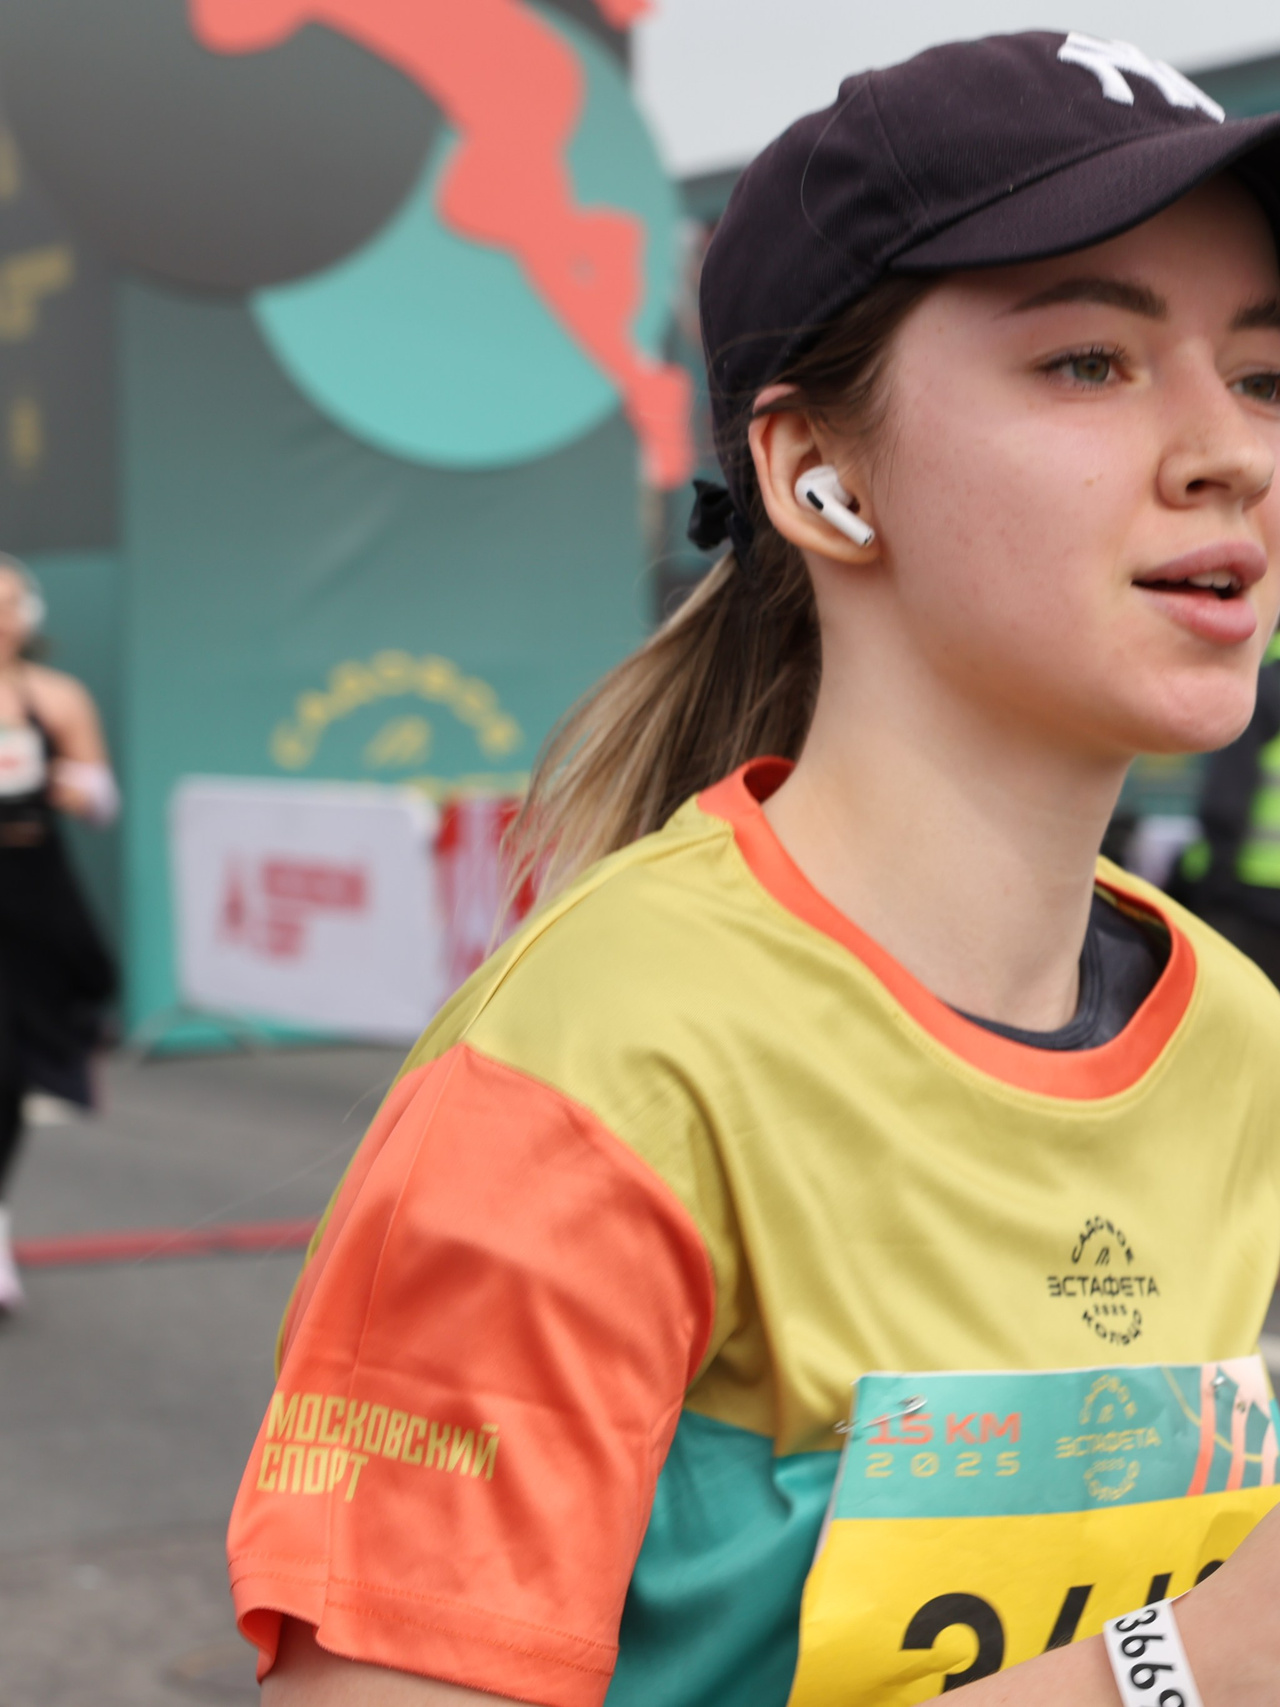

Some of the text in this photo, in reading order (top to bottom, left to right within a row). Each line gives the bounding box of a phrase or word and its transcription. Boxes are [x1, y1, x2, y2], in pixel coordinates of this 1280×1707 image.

[1047, 1274, 1160, 1298] ЭСТАФЕТА
[266, 1391, 500, 1481] МОСКОВСКИЙ
[866, 1413, 934, 1445] 15
[1055, 1427, 1162, 1459] ЭСТАФЕТА
[256, 1442, 368, 1503] СПОРТ
[865, 1451, 1021, 1478] 2025
